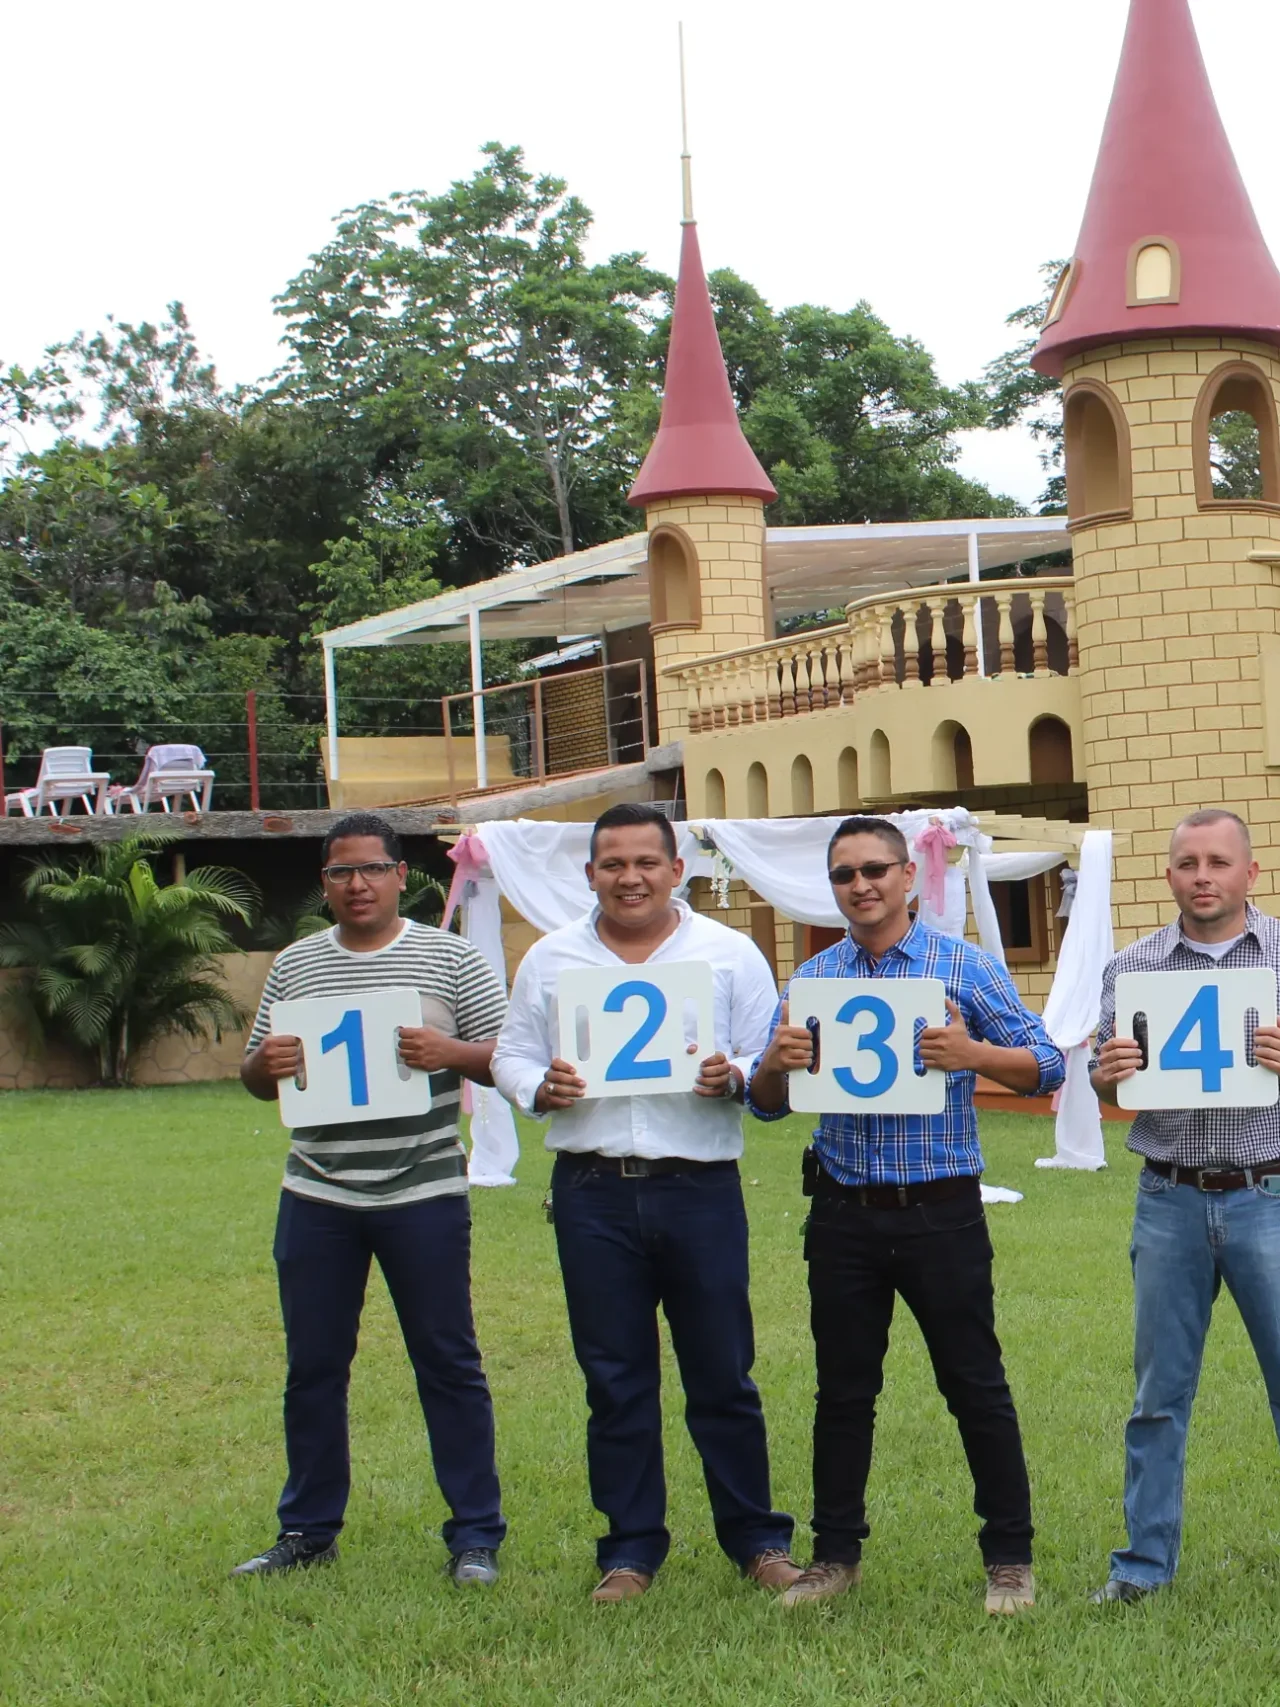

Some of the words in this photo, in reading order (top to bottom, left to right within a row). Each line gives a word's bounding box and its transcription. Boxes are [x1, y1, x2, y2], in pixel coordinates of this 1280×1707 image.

[322, 1010, 367, 1105] 1
[604, 981, 670, 1081] 2
[833, 996, 898, 1098] 3
[1160, 986, 1233, 1092] 4
